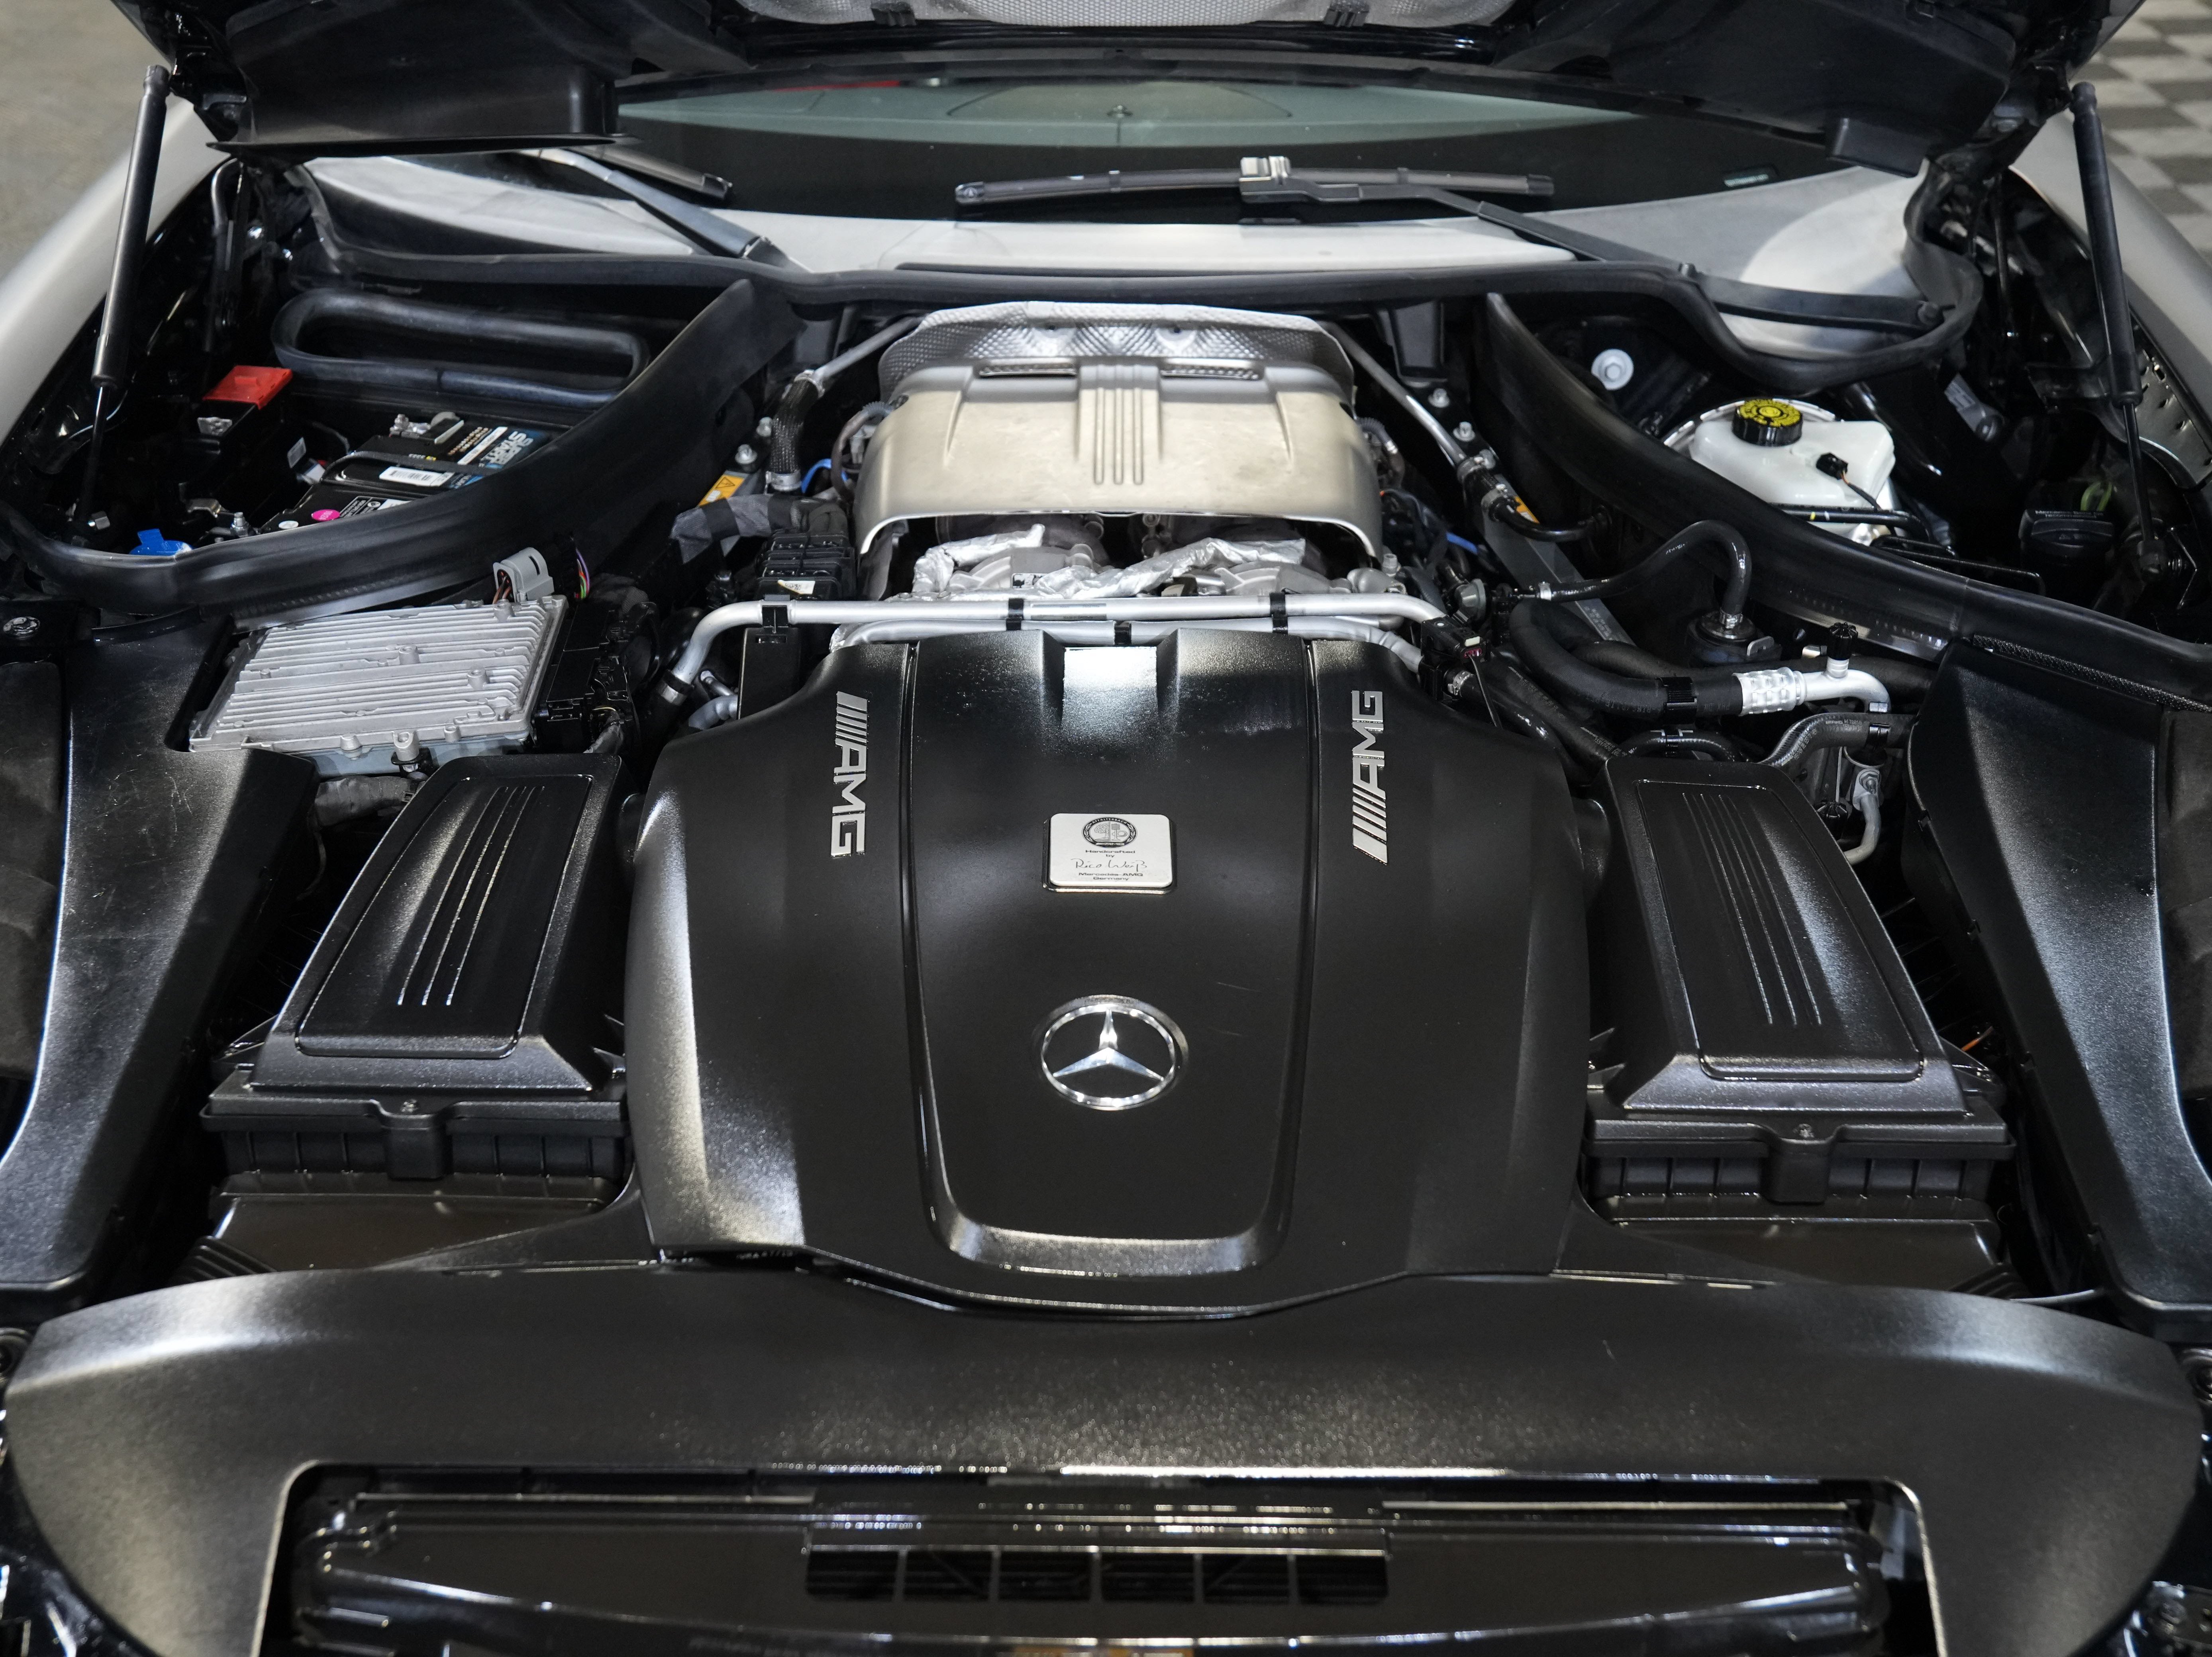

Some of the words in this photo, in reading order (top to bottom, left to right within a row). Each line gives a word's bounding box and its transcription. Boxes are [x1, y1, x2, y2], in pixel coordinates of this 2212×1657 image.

[480, 431, 527, 462] START
[490, 437, 534, 465] SUPER
[1071, 858, 1102, 869] Rico
